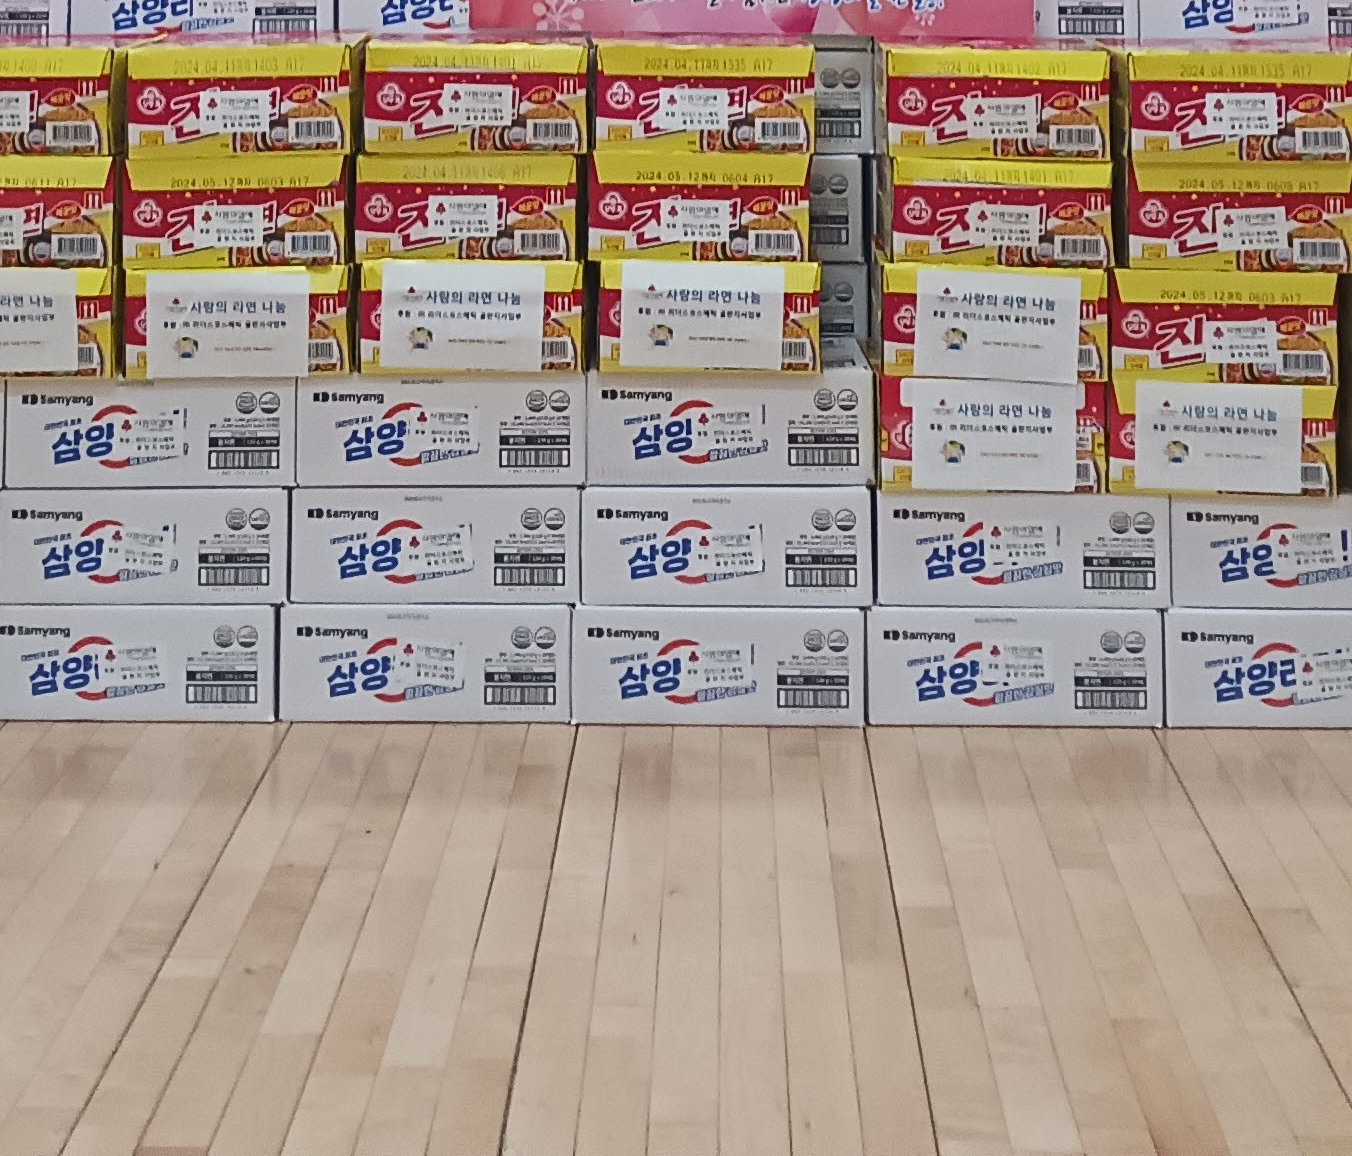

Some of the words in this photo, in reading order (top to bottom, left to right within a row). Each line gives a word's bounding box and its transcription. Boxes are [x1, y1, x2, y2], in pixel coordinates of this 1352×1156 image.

[0, 296, 23, 307] 라면
[30, 295, 53, 307] 나눔
[191, 301, 227, 314] 사랑의
[262, 301, 286, 314] 나눔
[427, 291, 462, 304] 사랑의
[468, 292, 492, 304] 라면
[498, 292, 520, 305] 나눔
[666, 289, 702, 302] 사랑의
[708, 290, 732, 304] 라면
[738, 291, 760, 305] 나눔
[961, 293, 997, 307] 사랑의
[1003, 296, 1026, 309] 라면
[1032, 297, 1055, 311] 나눔
[958, 403, 993, 417] 사랑의
[999, 405, 1022, 418] 라면
[1029, 405, 1051, 418] 나눔
[1182, 405, 1218, 420] 사랑의
[1224, 407, 1247, 421] 라면
[1254, 408, 1277, 422] 나눔
[54, 424, 114, 464] 삼양
[346, 421, 407, 461] 삼양
[634, 421, 693, 459] 삼양
[44, 539, 104, 579] 삼양
[339, 537, 401, 579] 삼양
[629, 538, 692, 579] 삼양
[927, 540, 985, 579] 삼양
[31, 654, 93, 695] 삼양
[330, 656, 391, 697] 삼양
[620, 658, 681, 699] 삼양
[917, 659, 980, 701] 삼양
